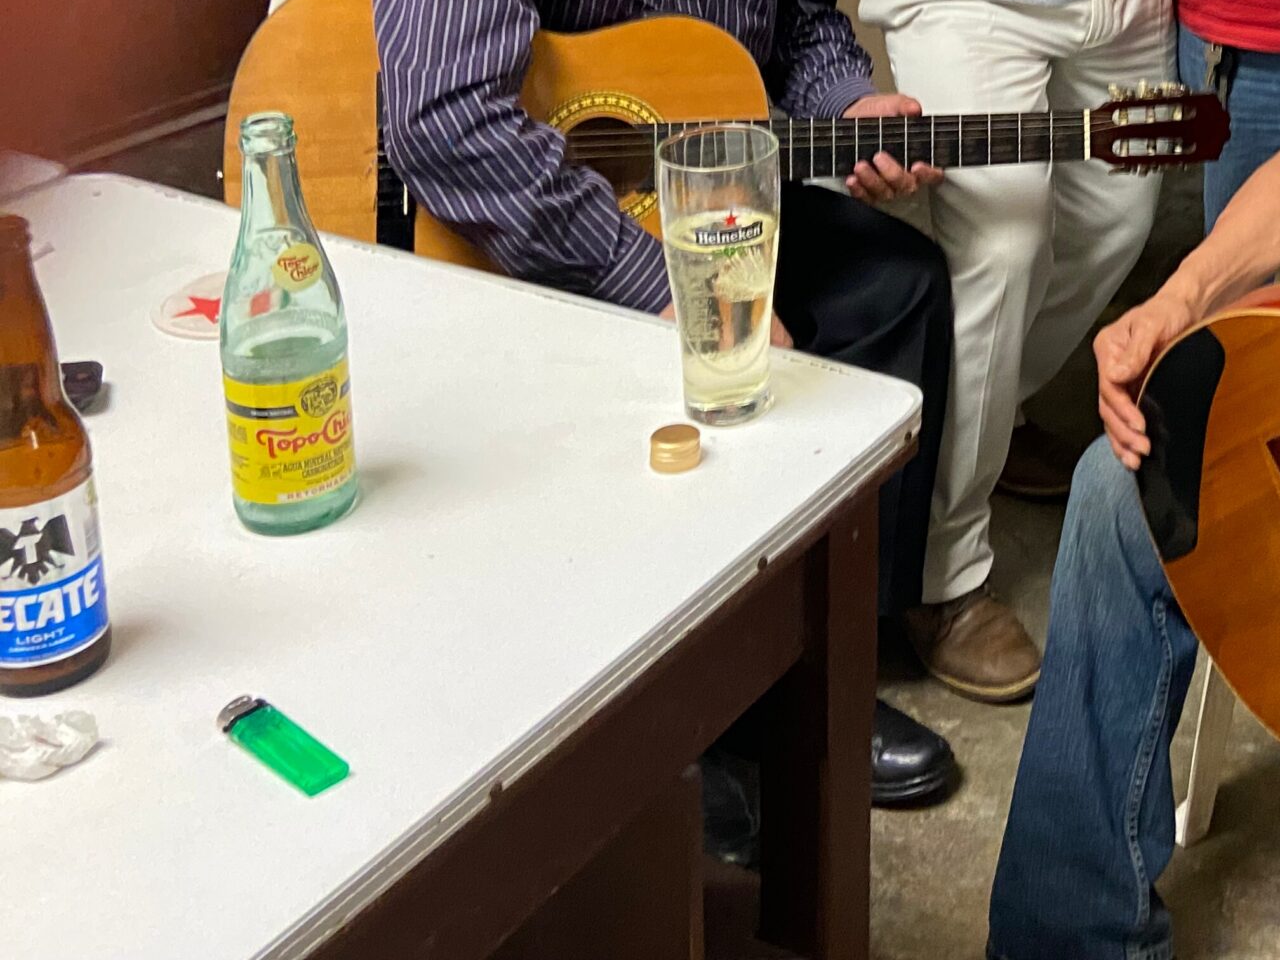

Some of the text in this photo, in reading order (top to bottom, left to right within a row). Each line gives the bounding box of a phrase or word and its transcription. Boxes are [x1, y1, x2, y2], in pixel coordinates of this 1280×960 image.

[698, 225, 761, 245] Heineken
[277, 256, 310, 273] Topo
[291, 263, 319, 282] Chico
[256, 426, 320, 459] Topo
[321, 409, 352, 445] Chic
[283, 461, 303, 474] AGUA
[287, 467, 354, 500] RETORNAB
[13, 532, 43, 564] T
[0, 563, 101, 633] ECATE
[16, 626, 66, 646] LIGHT
